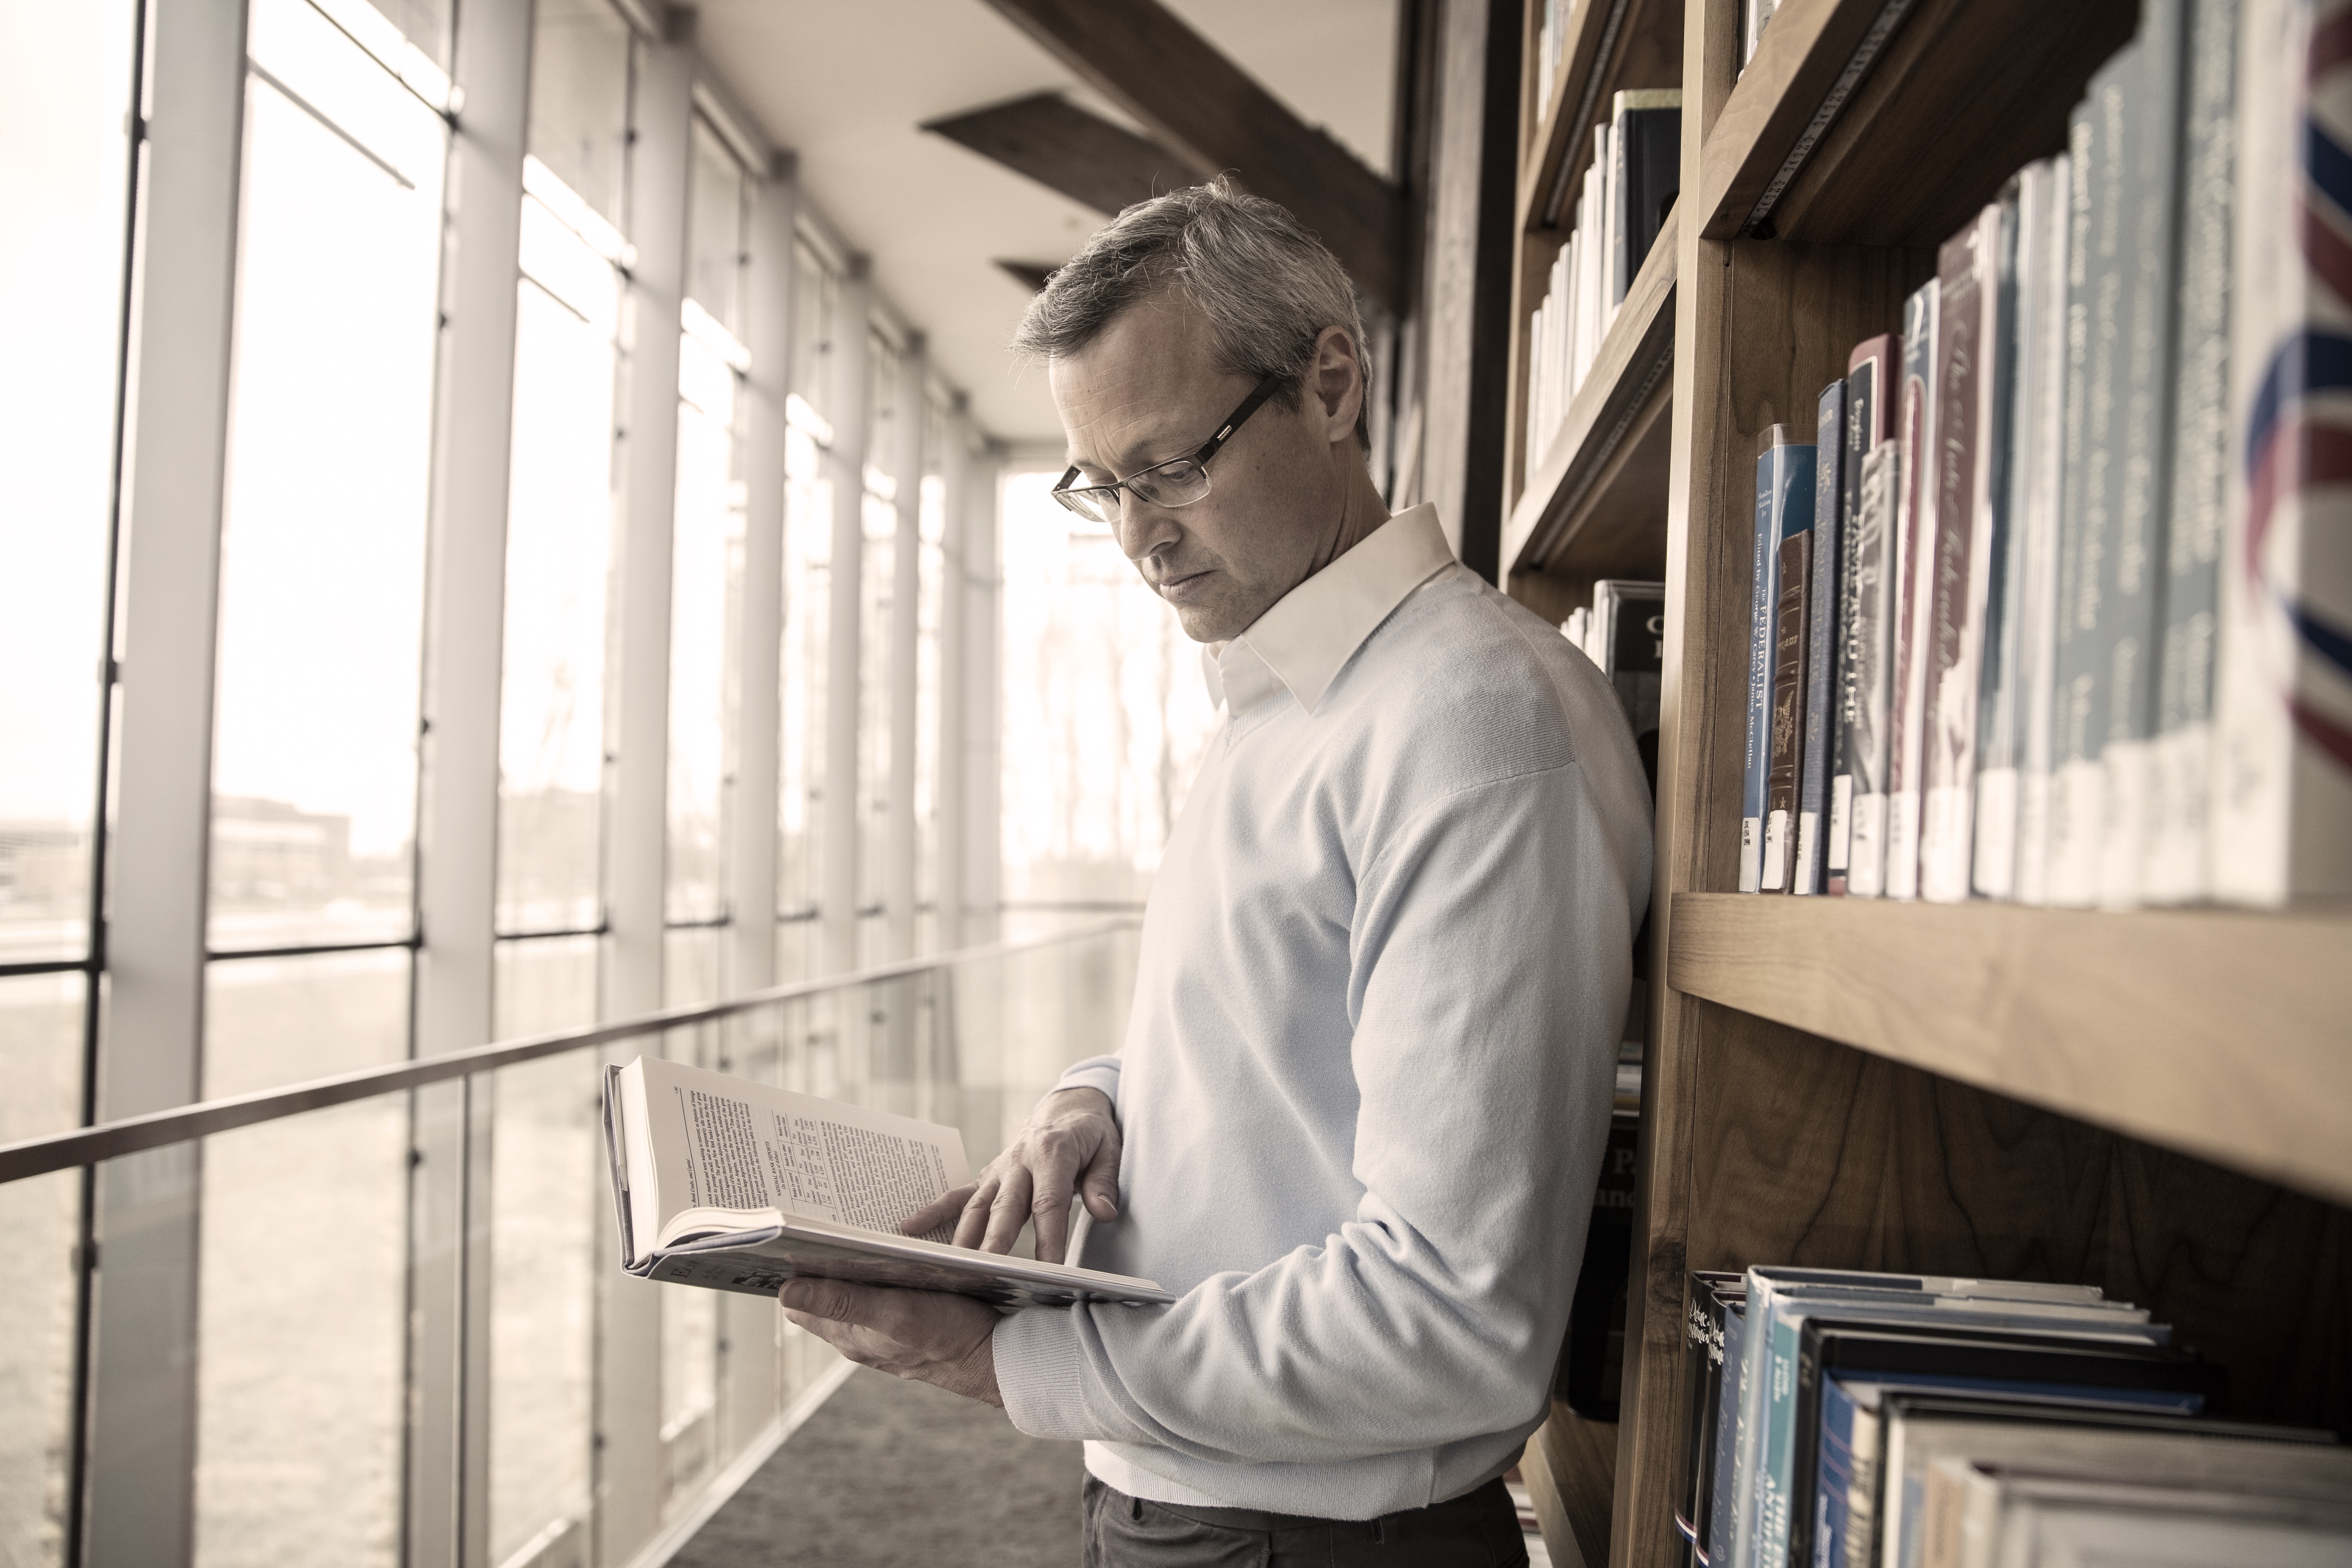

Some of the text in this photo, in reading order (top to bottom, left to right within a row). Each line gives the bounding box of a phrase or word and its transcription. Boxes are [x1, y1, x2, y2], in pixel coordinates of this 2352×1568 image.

[1758, 490, 1771, 500] Hamilton
[1755, 569, 1761, 582] by
[1756, 605, 1767, 710] FEDERALIST
